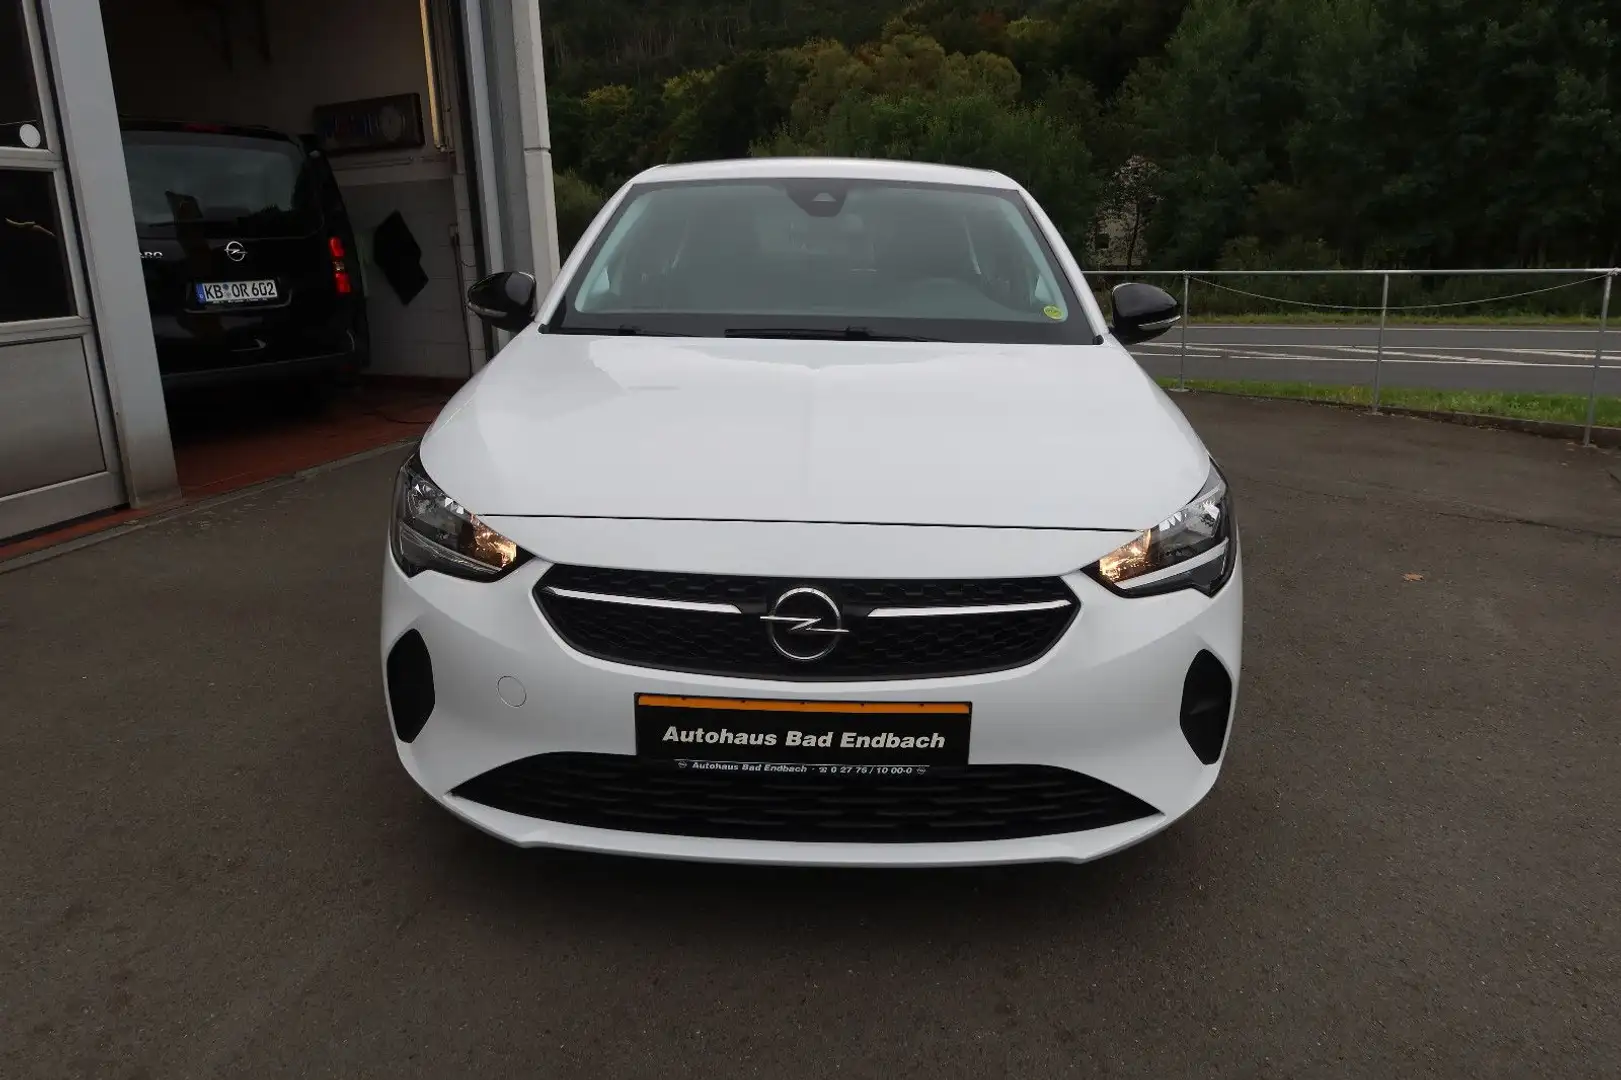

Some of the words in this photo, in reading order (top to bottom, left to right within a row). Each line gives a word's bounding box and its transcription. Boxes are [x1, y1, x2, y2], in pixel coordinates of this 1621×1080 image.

[204, 284, 224, 299] KB
[231, 283, 250, 298] OR
[251, 282, 276, 297] 602
[662, 725, 777, 746] Autohaus
[785, 730, 833, 747] Bad
[840, 732, 946, 749] Endbach
[692, 762, 738, 770] Autohaus
[741, 763, 762, 771] Bad
[763, 764, 807, 773] Endbach
[830, 766, 837, 774] 0
[839, 766, 853, 774] 27
[876, 766, 889, 774] 10
